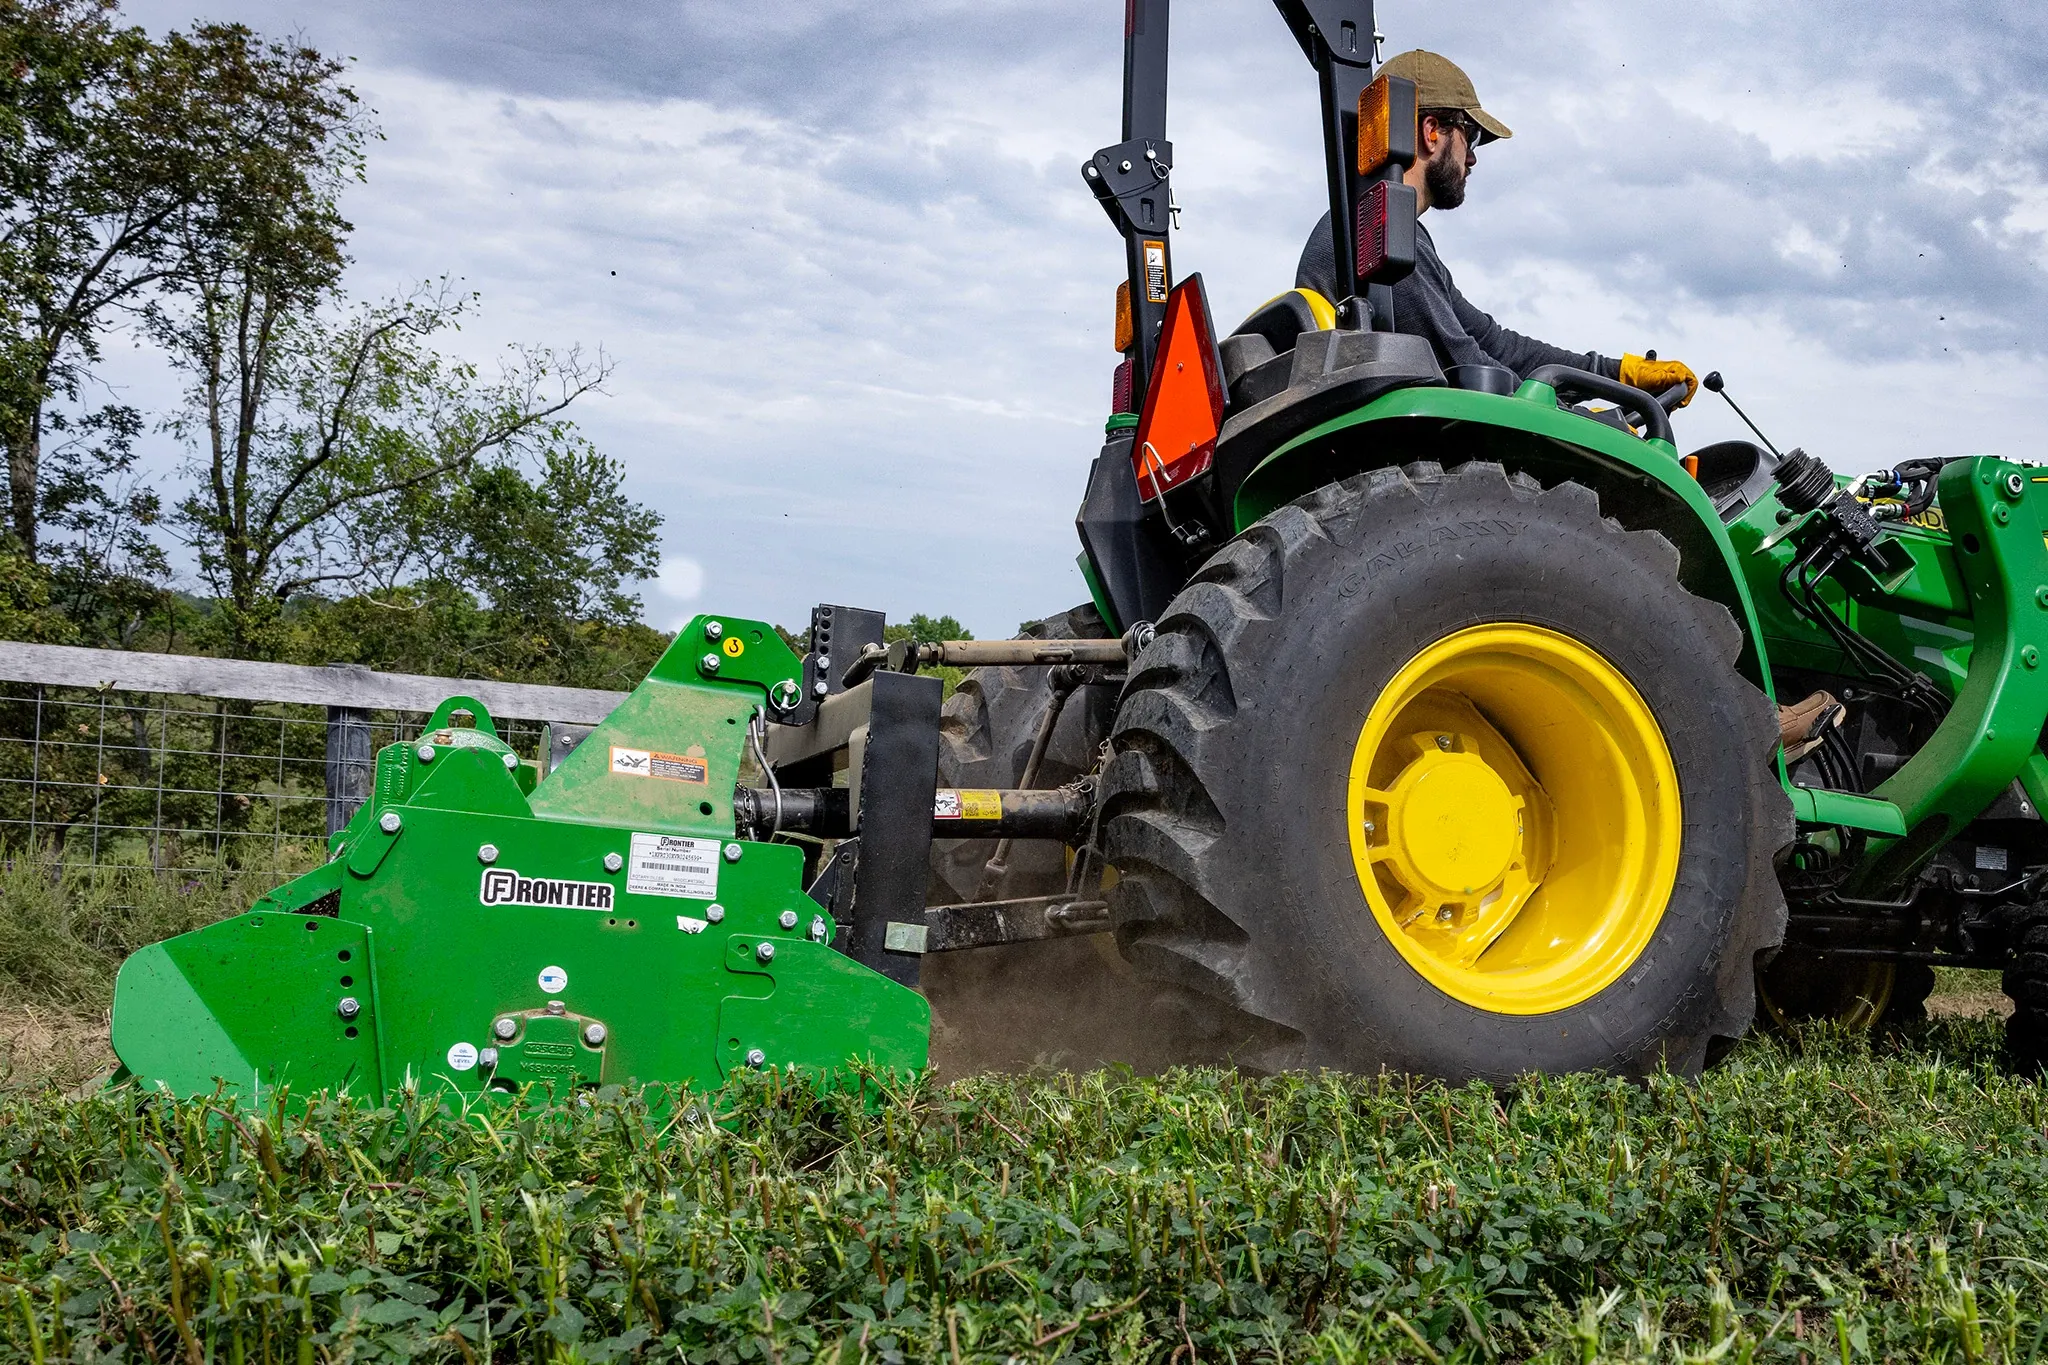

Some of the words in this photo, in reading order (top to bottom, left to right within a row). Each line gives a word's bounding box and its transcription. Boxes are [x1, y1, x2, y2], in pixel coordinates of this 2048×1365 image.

[1338, 519, 1524, 600] GALAXY
[661, 836, 695, 848] FRONTIER
[484, 870, 612, 909] FRONTIER
[526, 1043, 575, 1057] MASCHIO
